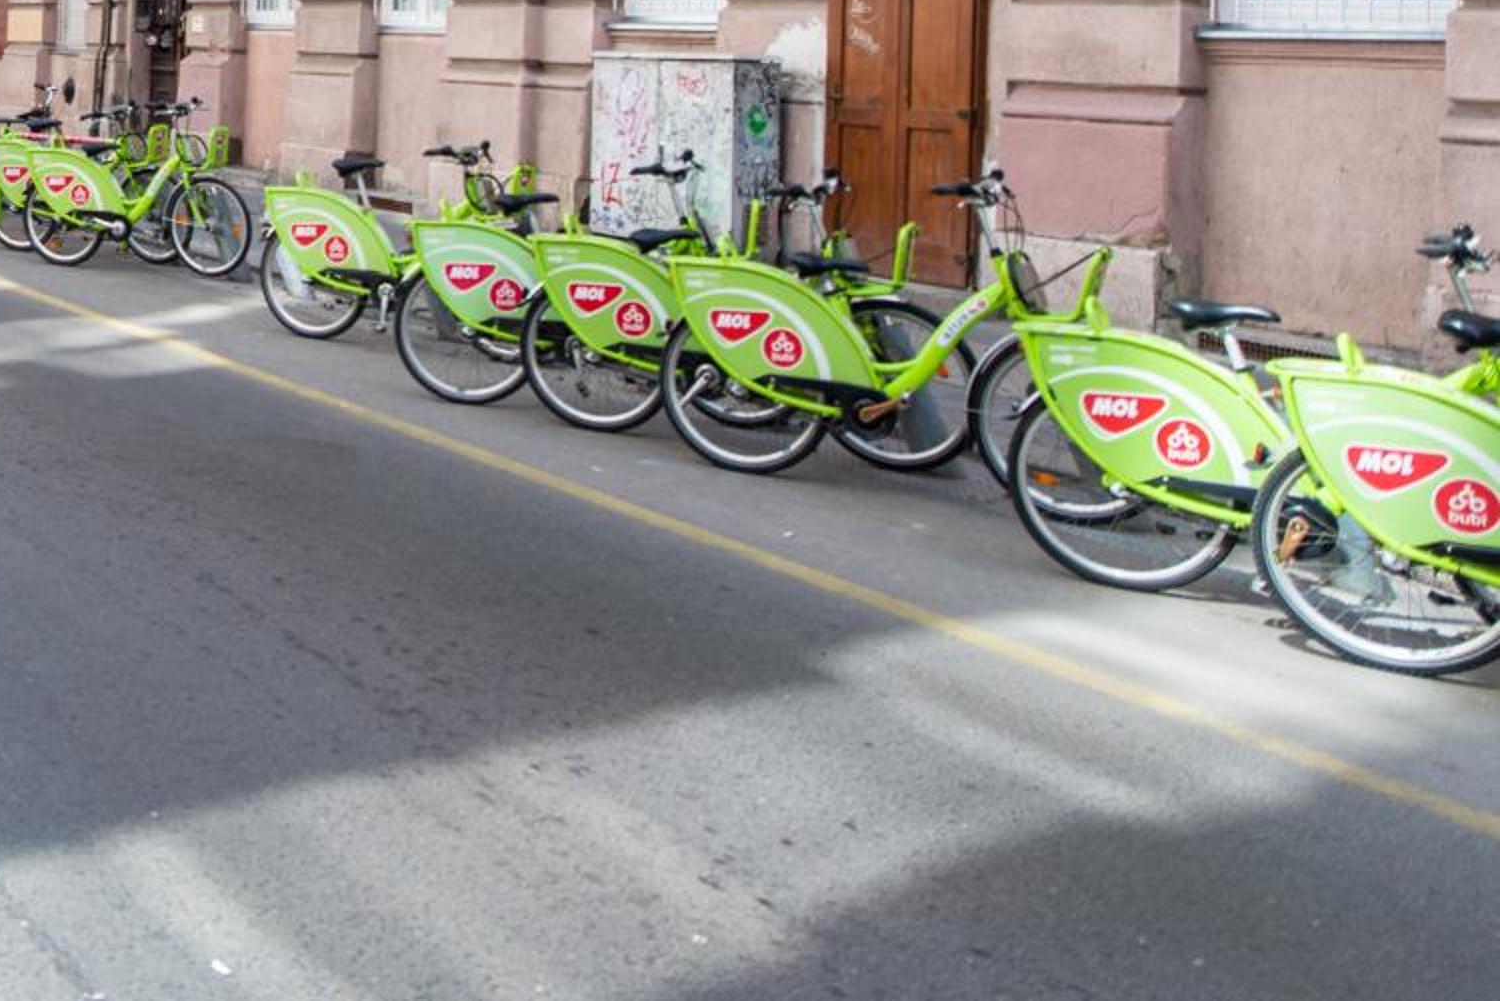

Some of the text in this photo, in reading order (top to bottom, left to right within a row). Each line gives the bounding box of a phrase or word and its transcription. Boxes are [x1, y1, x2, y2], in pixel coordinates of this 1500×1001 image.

[716, 312, 752, 329] MOL
[1091, 397, 1140, 419] MOL
[1356, 450, 1414, 476] MOL
[1447, 510, 1488, 528] bubi
